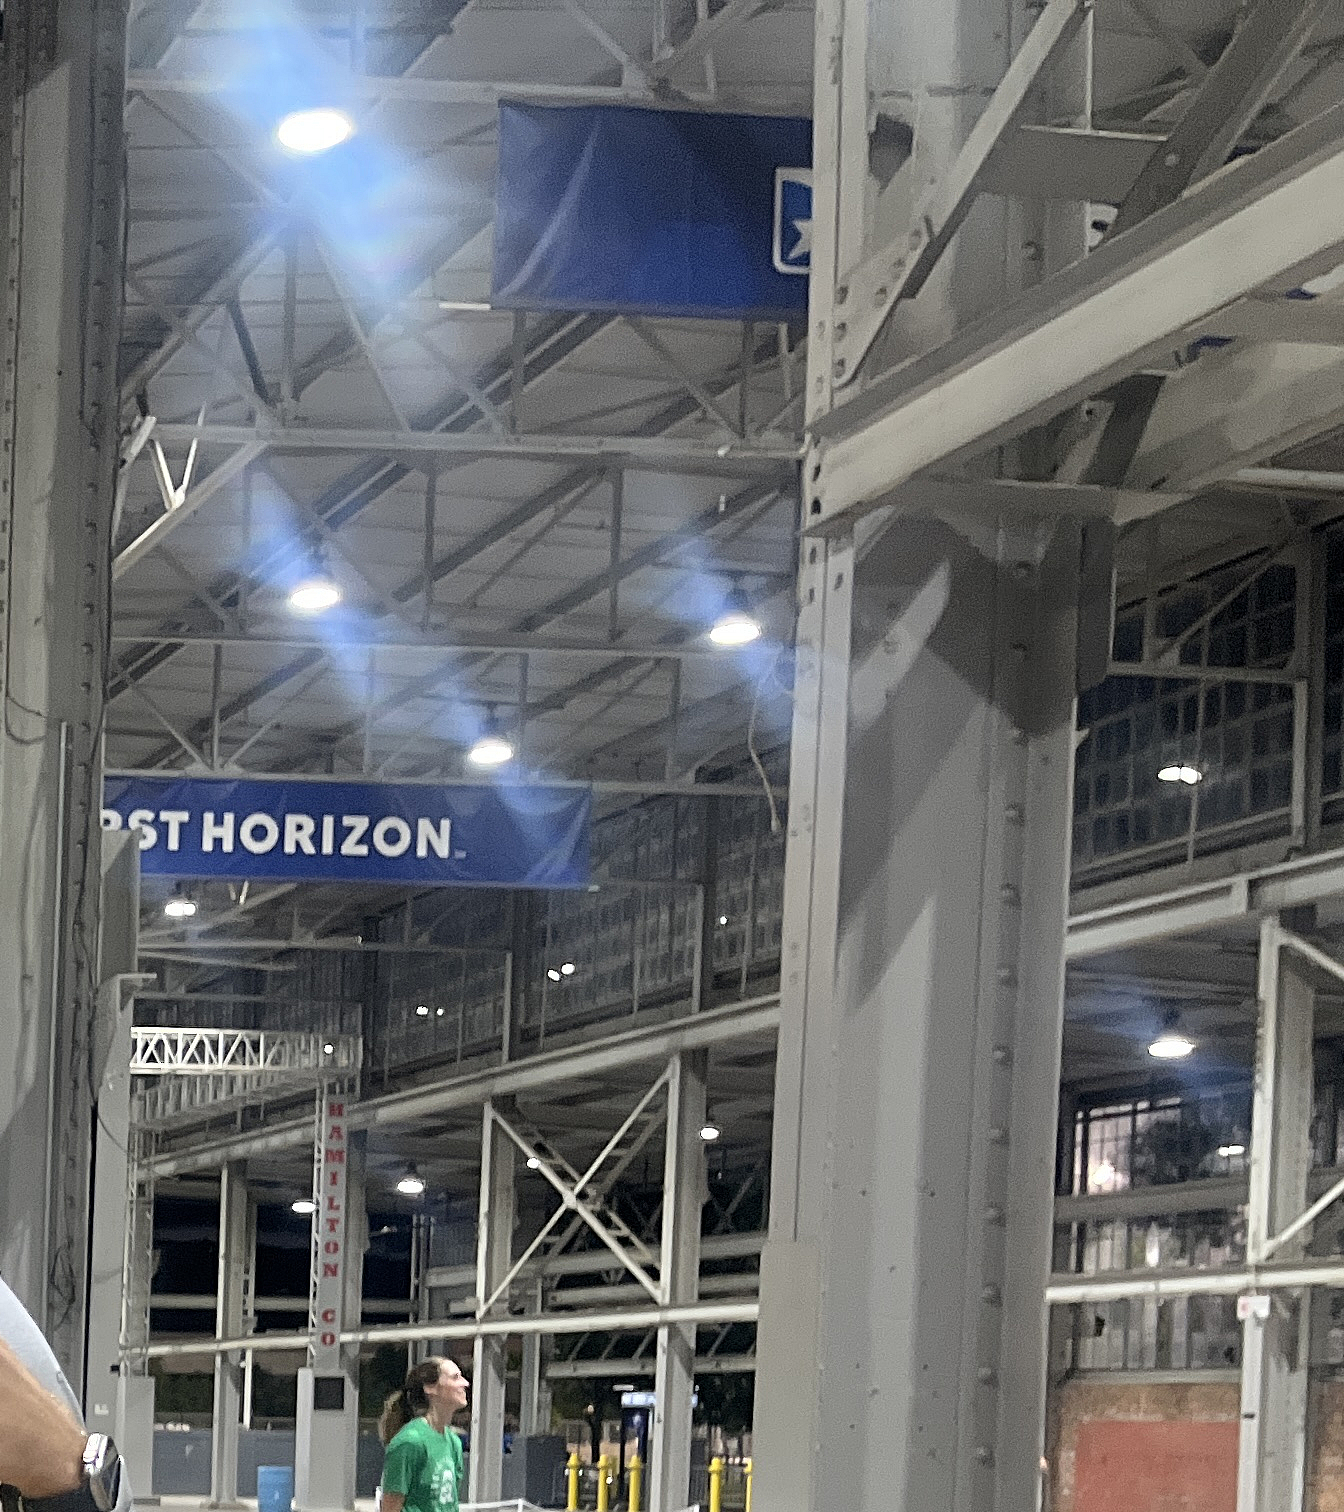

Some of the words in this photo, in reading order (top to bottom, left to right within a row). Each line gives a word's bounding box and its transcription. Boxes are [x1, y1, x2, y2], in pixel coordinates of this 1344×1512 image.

[202, 812, 452, 860] HORIZON
[322, 1103, 346, 1278] HAMILTON
[321, 1308, 337, 1347] CO
